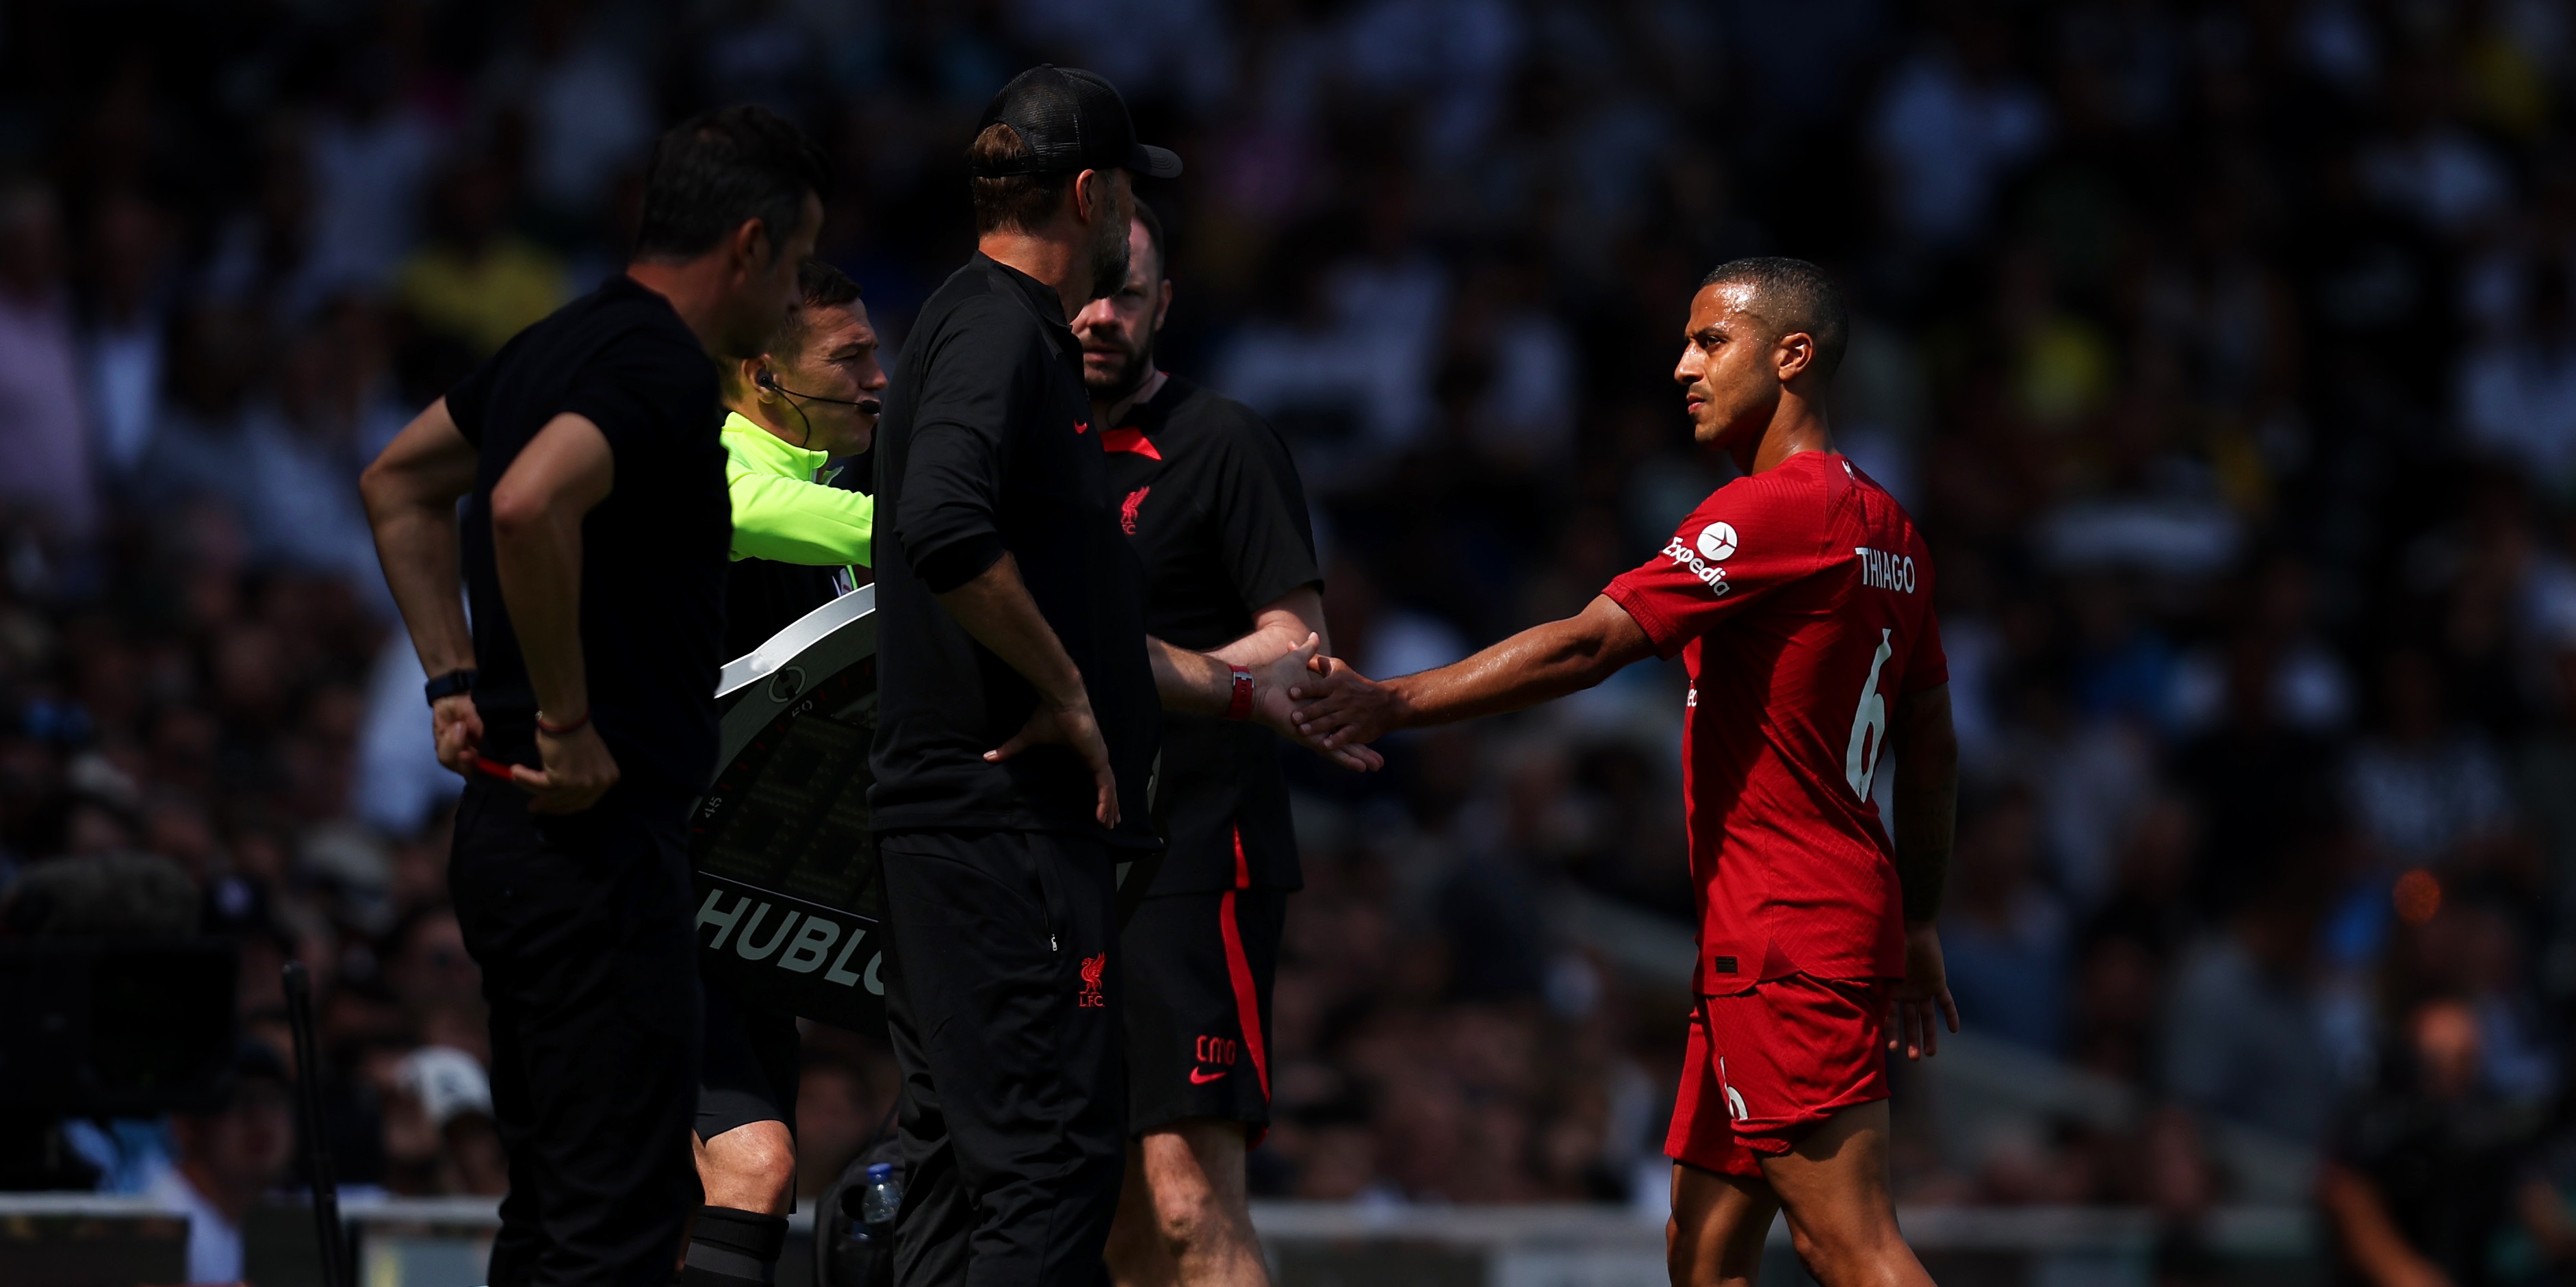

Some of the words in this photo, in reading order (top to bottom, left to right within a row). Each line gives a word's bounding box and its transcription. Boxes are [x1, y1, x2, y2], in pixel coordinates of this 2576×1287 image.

[1662, 536, 1730, 596] Expedia
[1855, 547, 1915, 594] THIAGO
[1846, 628, 1892, 804] 6
